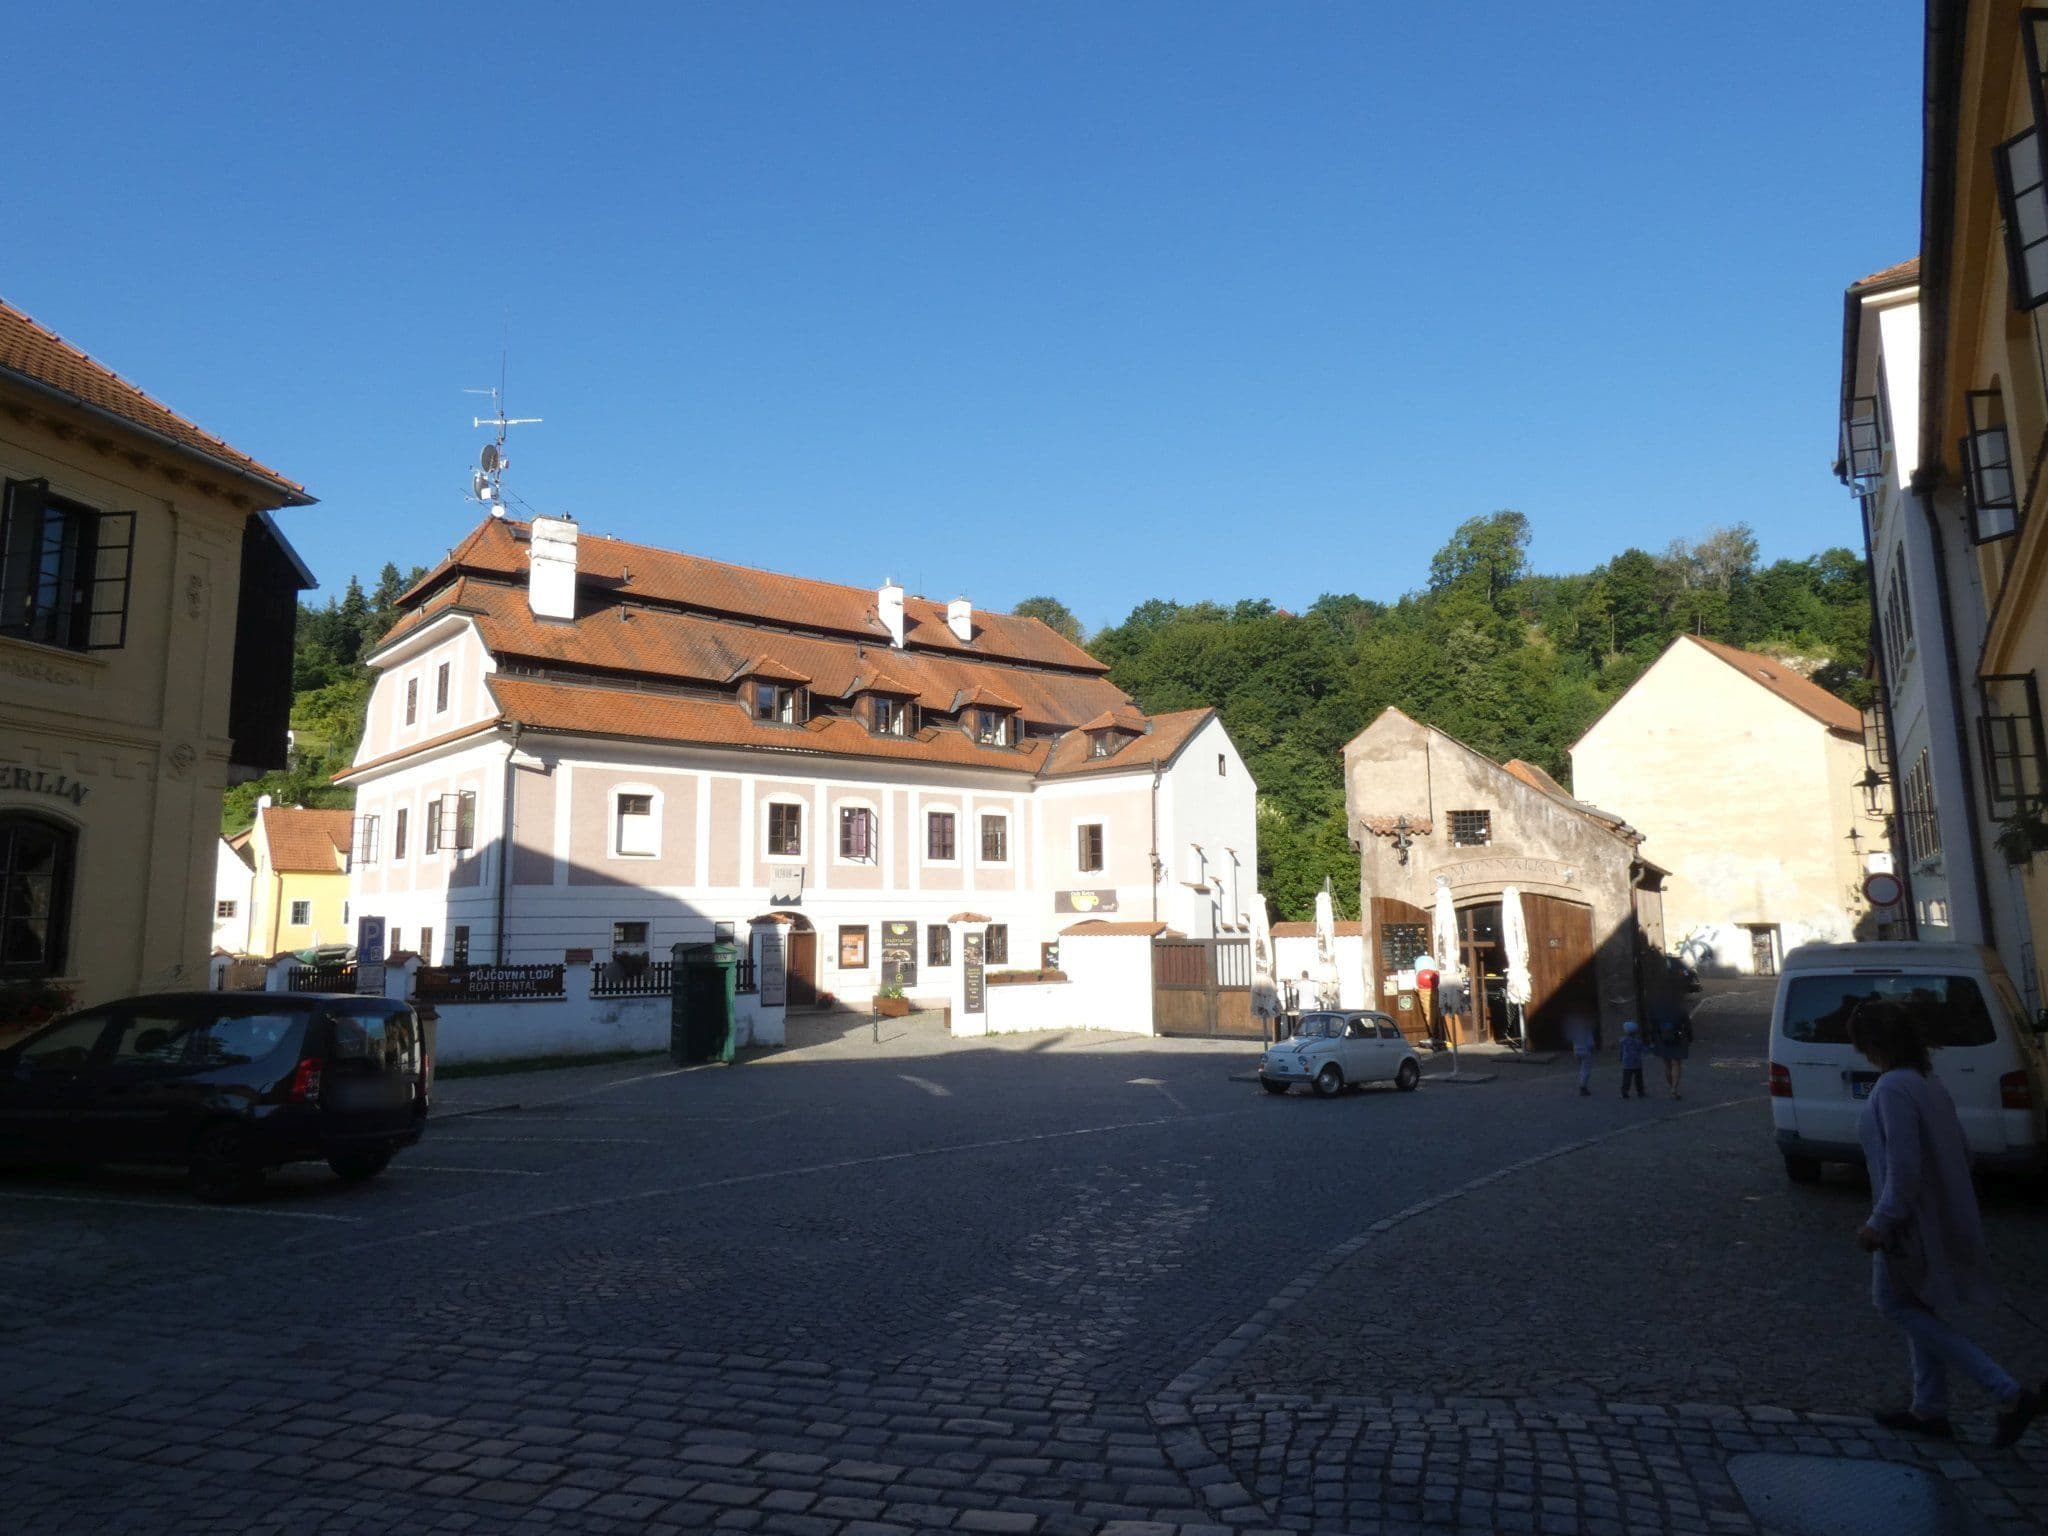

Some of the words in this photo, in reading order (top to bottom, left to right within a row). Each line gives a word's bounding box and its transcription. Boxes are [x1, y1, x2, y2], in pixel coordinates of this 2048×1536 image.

[364, 921, 379, 949] P
[468, 981, 495, 992] BOAT
[498, 980, 537, 991] RENTAL
